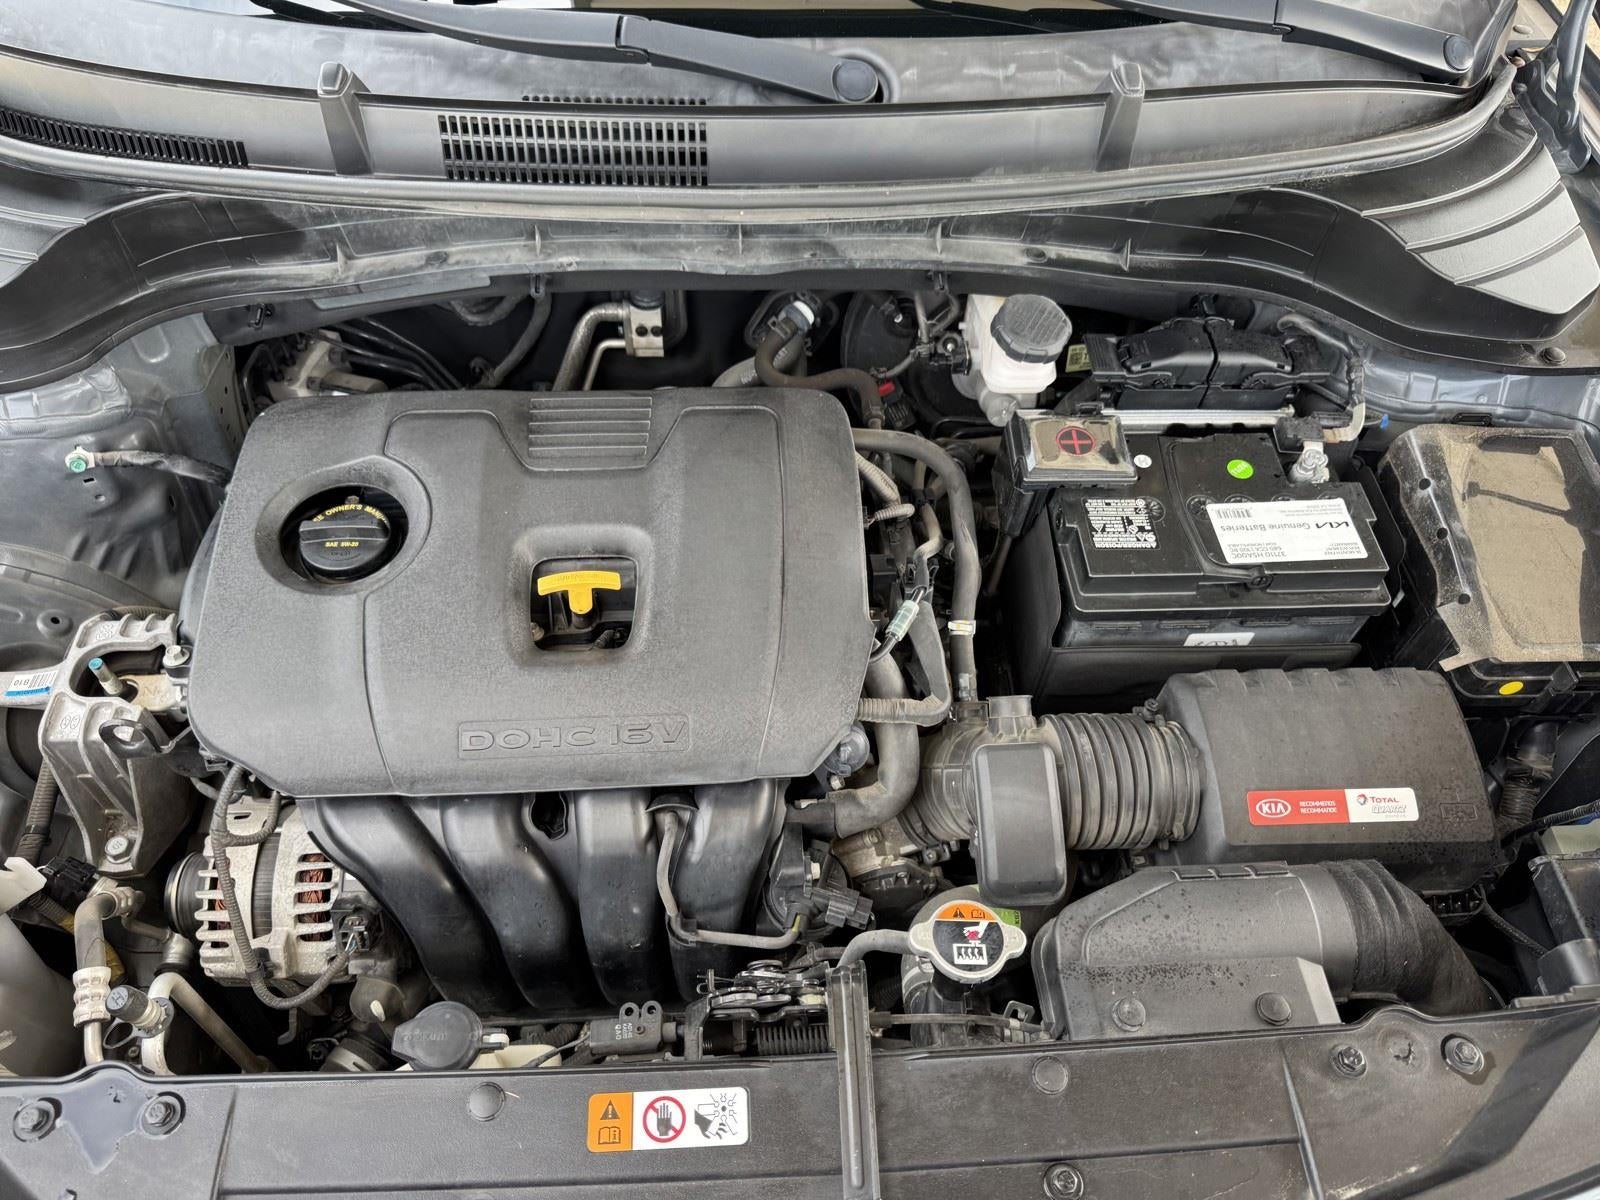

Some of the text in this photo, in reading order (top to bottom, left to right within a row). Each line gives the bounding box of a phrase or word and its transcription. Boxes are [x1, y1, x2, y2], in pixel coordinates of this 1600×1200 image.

[325, 504, 362, 515] OWNER'S
[1220, 521, 1350, 532] KIA Genuine Batteries
[462, 721, 686, 751] DOHC 16V
[1370, 796, 1400, 804] TOTAL
[1262, 803, 1286, 814] KIA
